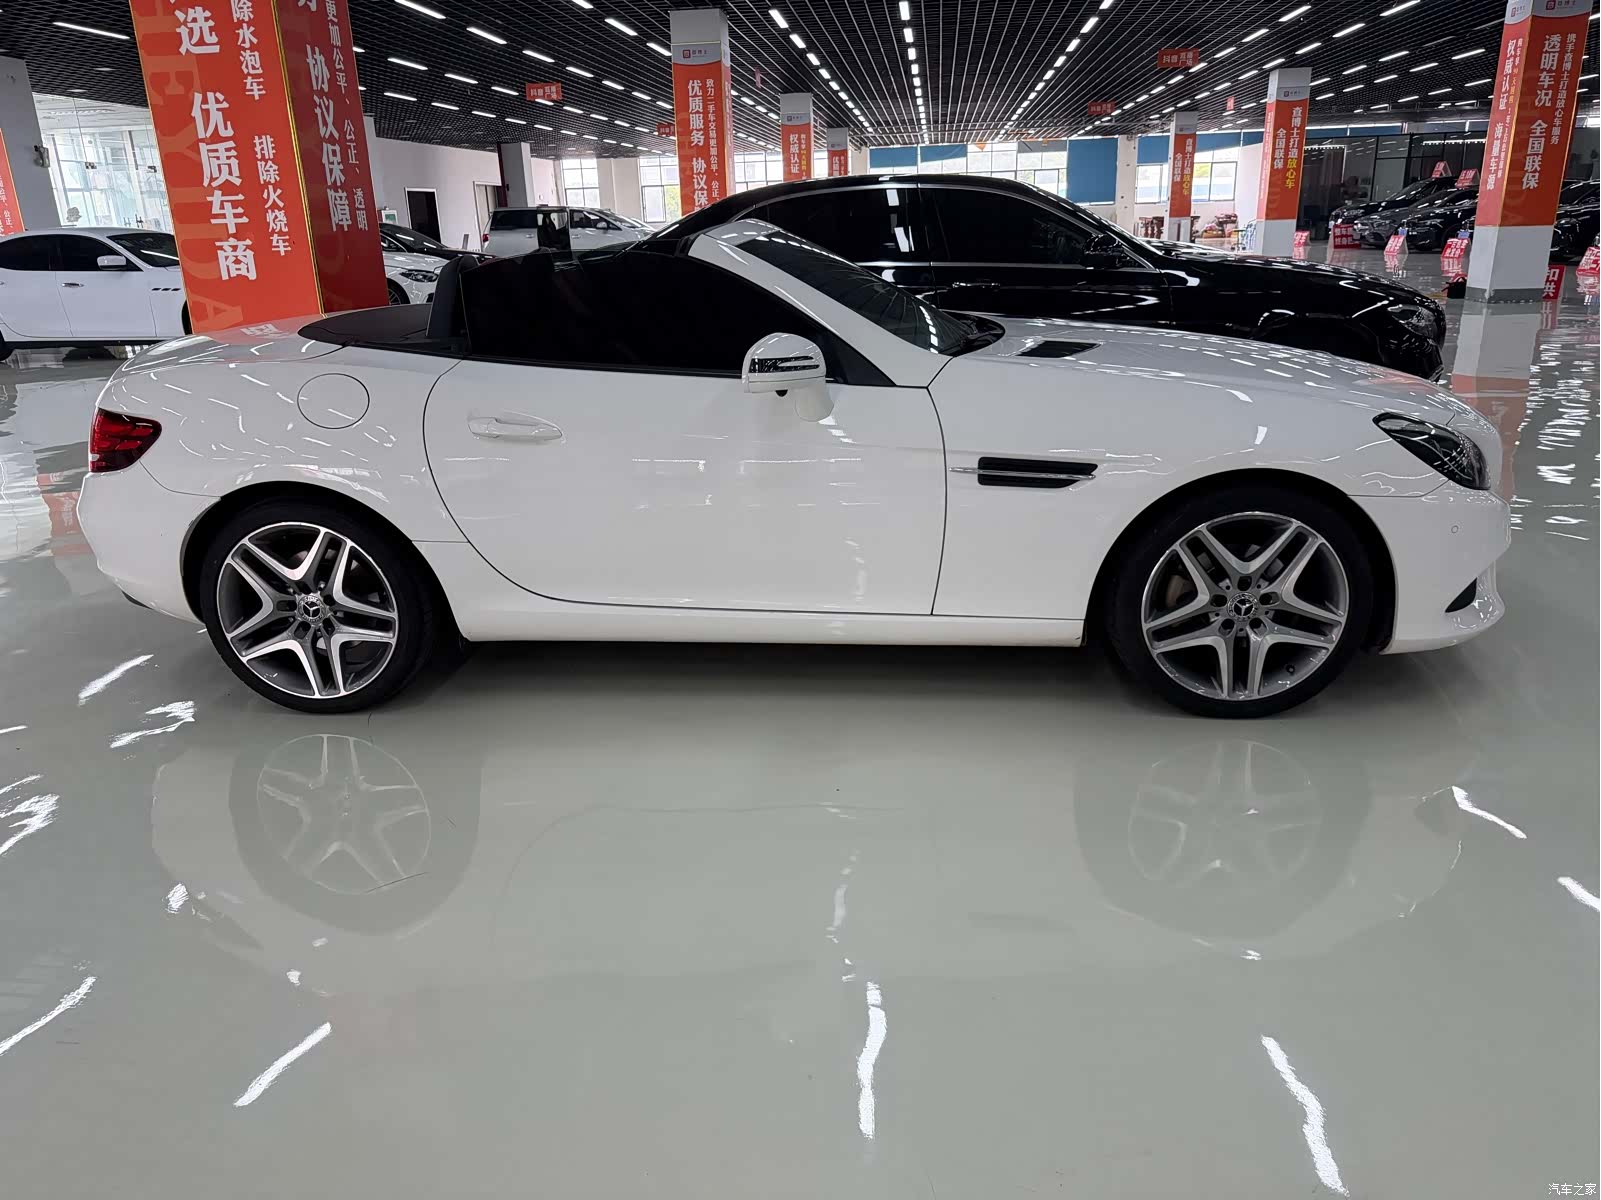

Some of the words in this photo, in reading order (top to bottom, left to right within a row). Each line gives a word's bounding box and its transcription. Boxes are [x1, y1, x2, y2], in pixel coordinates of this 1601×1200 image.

[1534, 33, 1562, 107] 透明车况
[306, 44, 352, 232] 协议保障
[688, 79, 704, 146] 优质服务
[1272, 127, 1287, 169] 全国联保
[1285, 106, 1303, 189] 查博士打造放心车
[192, 91, 257, 281] 优质车商
[692, 157, 709, 212] 协议保
[1522, 119, 1548, 190] 全国联保
[253, 135, 292, 256] 排除火烧车
